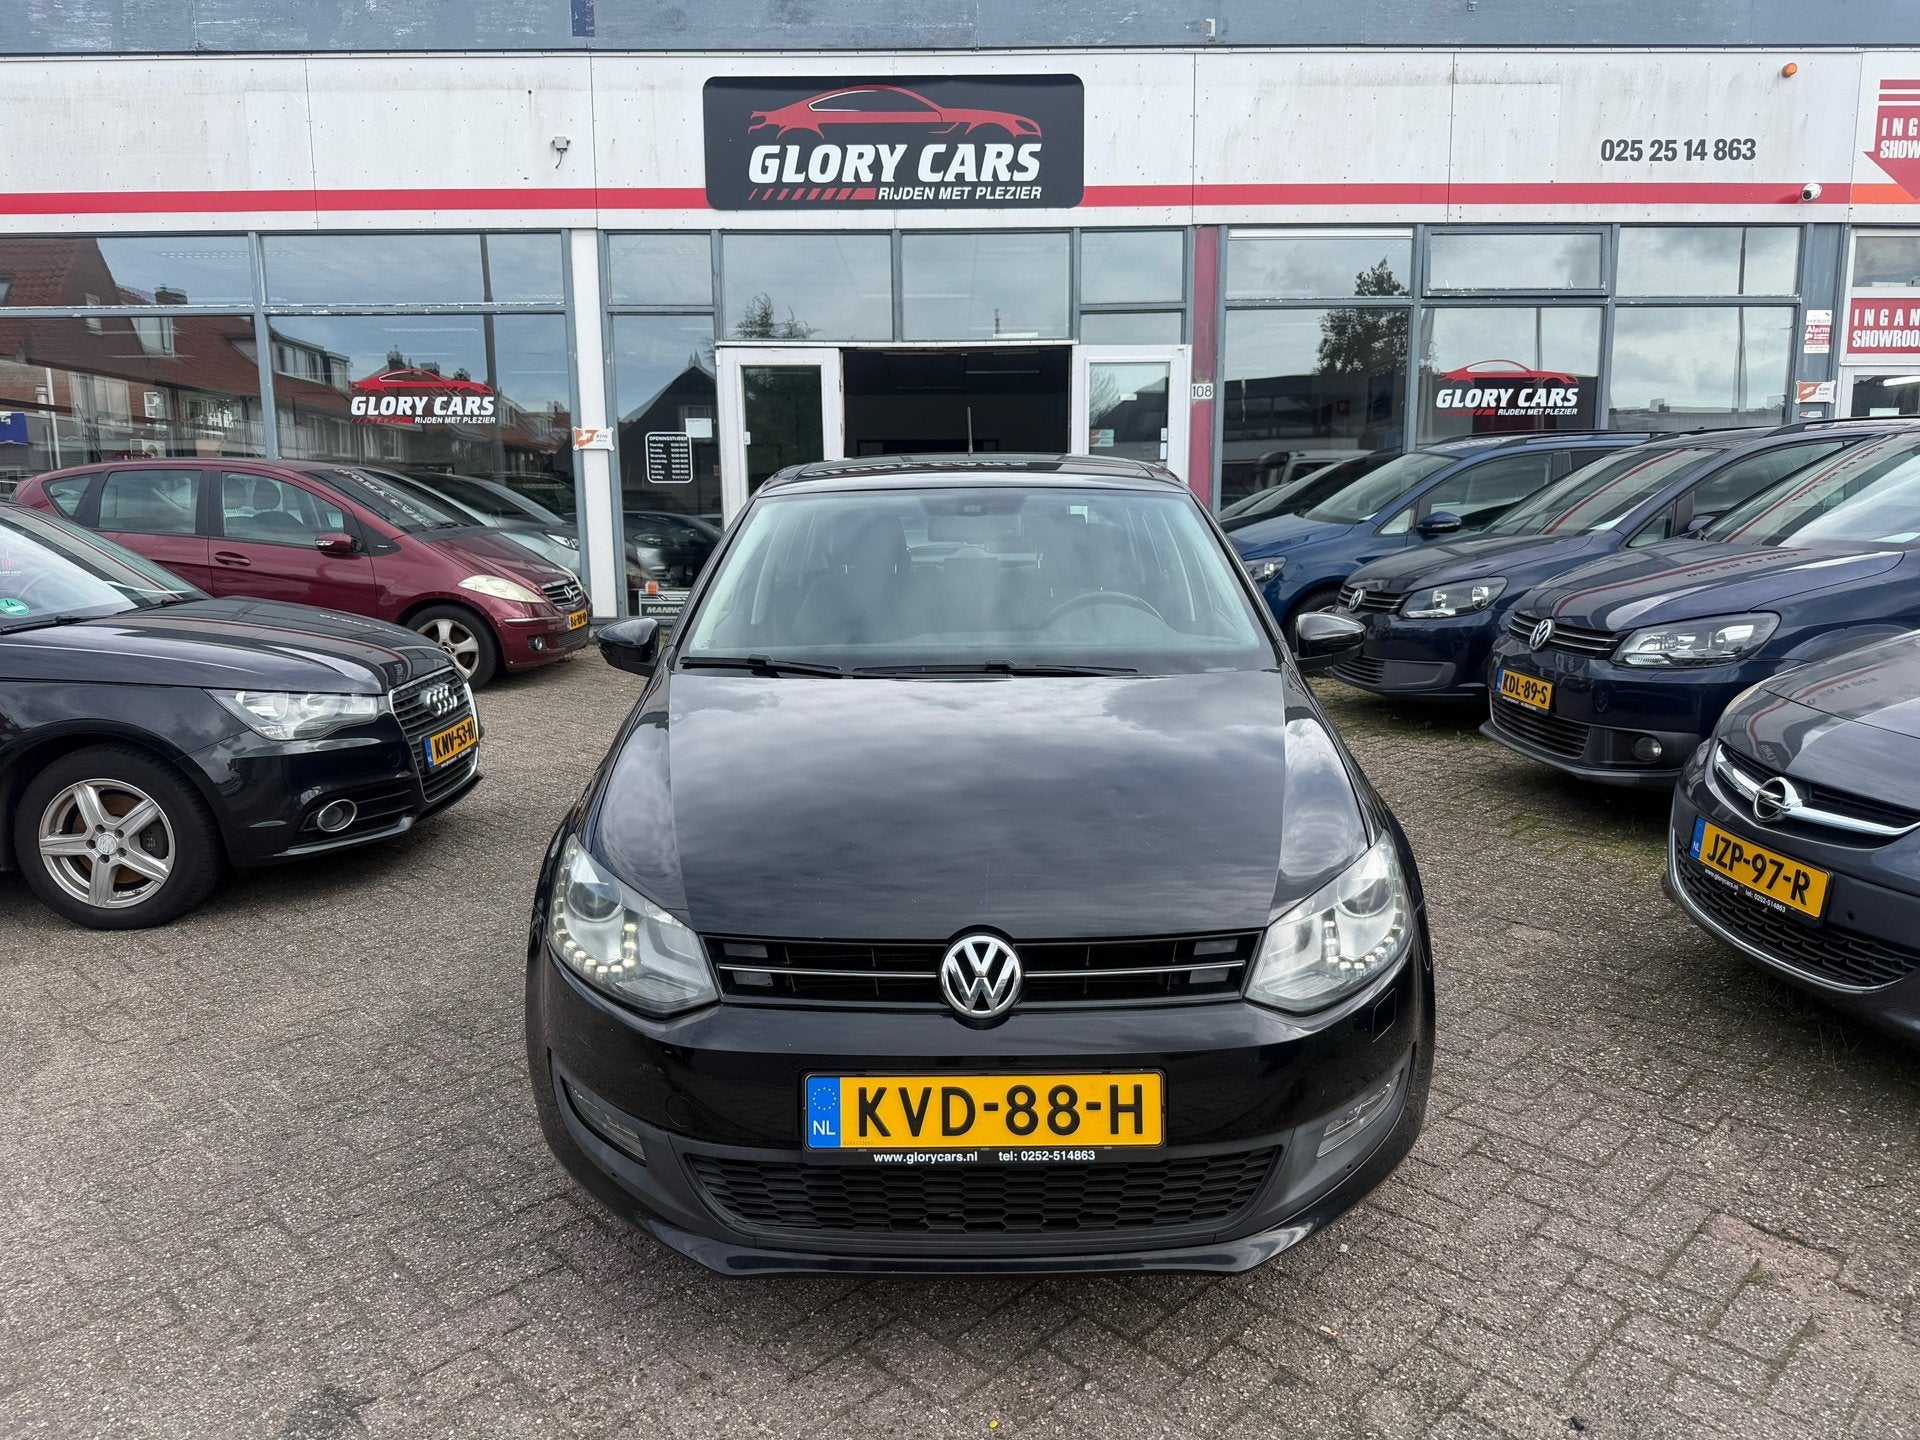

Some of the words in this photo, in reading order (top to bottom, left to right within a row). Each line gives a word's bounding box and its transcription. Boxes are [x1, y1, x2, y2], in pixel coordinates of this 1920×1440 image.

[1600, 139, 1643, 162] 025
[1649, 139, 1677, 162] 25
[1683, 139, 1708, 161] 14
[1713, 138, 1756, 161] 863
[748, 144, 907, 183] GLORY
[917, 143, 1042, 182] CARS
[878, 187, 935, 200] RIJDEN
[938, 187, 971, 200] MET
[975, 186, 1042, 200] PLEZIER
[1806, 326, 1830, 334] Alarm
[1192, 385, 1213, 398] 108
[1436, 389, 1514, 408] GLORY
[1517, 388, 1579, 407] CARS
[350, 396, 429, 416] GLORY
[433, 396, 495, 416] CARS
[1502, 673, 1548, 704] KDL-89-S
[1692, 840, 1700, 852] NL
[1706, 833, 1811, 905] JZP-97-R
[812, 1120, 836, 1136] NL
[858, 1084, 1144, 1137] KVD-88-H
[873, 1152, 978, 1165] www.glorycars.nl
[998, 1151, 1018, 1162] tel:
[1020, 1151, 1096, 1162] 0252-514863
